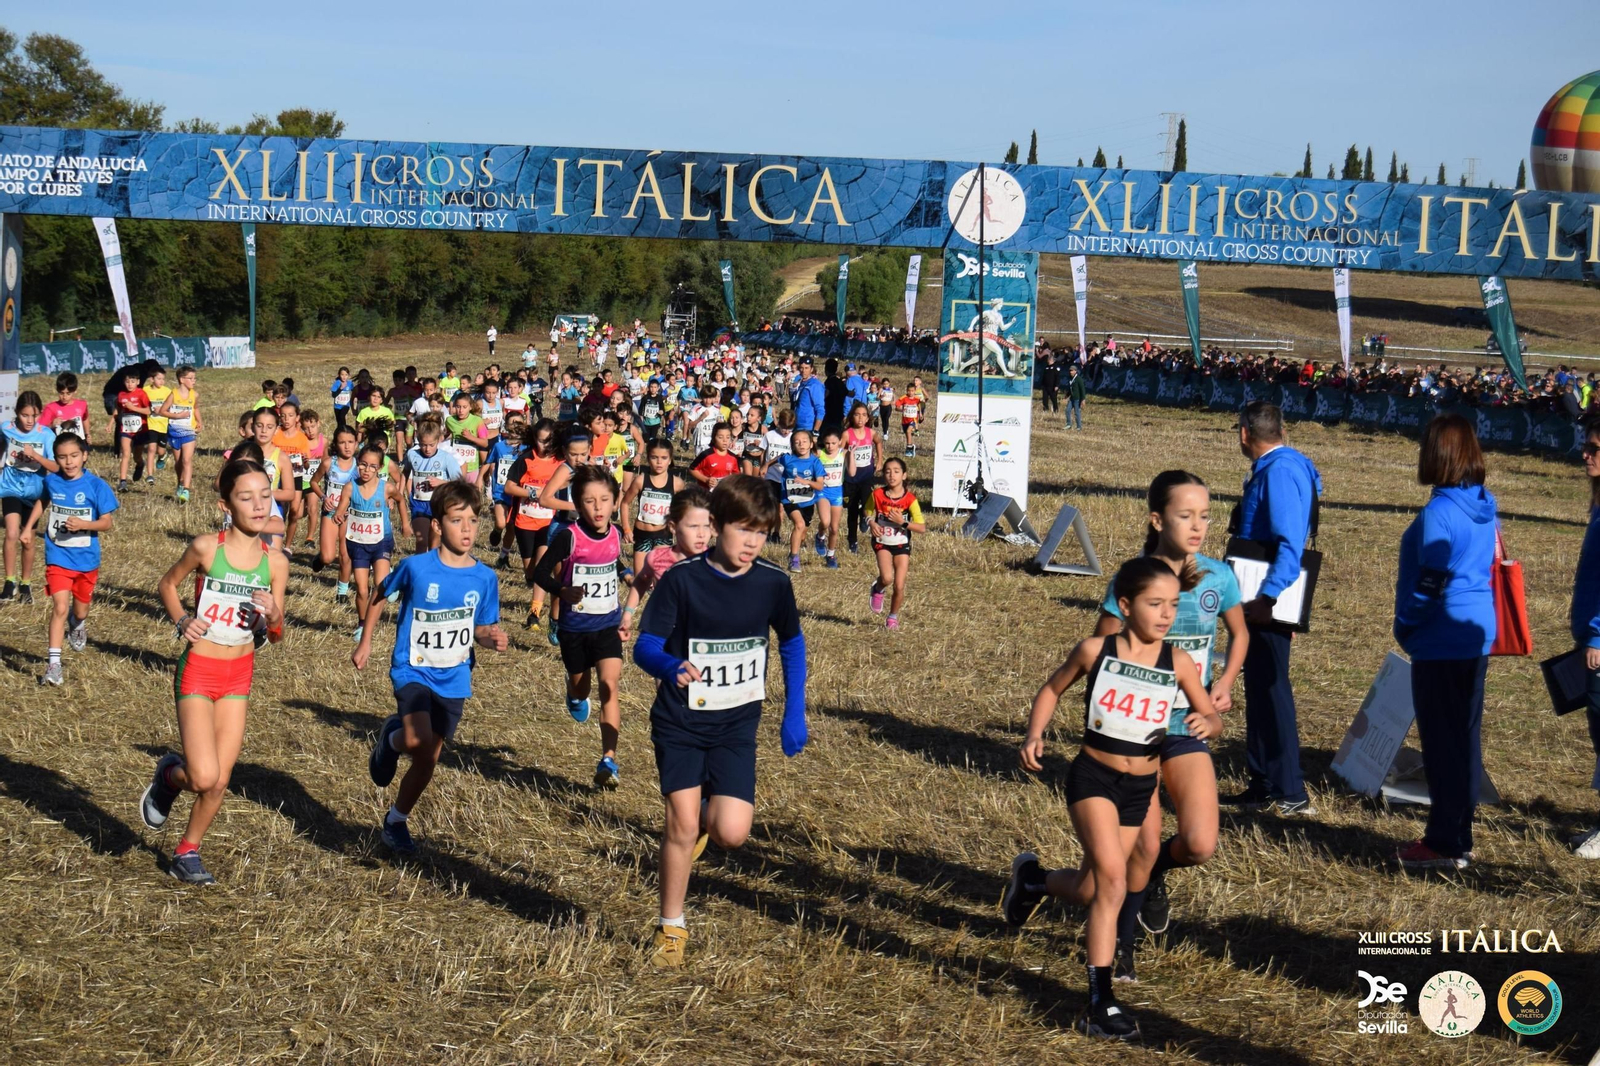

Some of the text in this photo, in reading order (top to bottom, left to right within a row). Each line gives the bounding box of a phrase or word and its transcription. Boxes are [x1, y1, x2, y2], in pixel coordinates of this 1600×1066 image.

[0, 154, 148, 172] ATO DE ANDALUCÍA
[371, 155, 494, 188] CROSS
[42, 169, 54, 182] A
[57, 170, 114, 184] TRAVÉS
[208, 148, 367, 204] XLIII
[28, 183, 82, 196] CLUBES
[551, 150, 852, 227] ITÁLICA
[955, 172, 1019, 202] ITLICA
[371, 189, 539, 210] INTERNACIONAL
[1069, 179, 1228, 238] XLIII
[1234, 188, 1358, 224] CROSS
[208, 204, 509, 229] INTERNATIONAL CROSS COUNTRY
[1233, 223, 1403, 247] INTERNACIONAL
[1068, 236, 1372, 265] INTERNATIONAL CROSS COUNTRY
[992, 269, 1025, 278] Sevilla
[124, 419, 140, 427] 4140
[855, 453, 871, 461] 245
[825, 471, 842, 481] 367
[350, 522, 381, 535] 4443
[224, 584, 255, 597] ITÁLIC
[581, 579, 616, 598] 4213
[417, 628, 470, 649] 4170
[712, 642, 749, 653] ITÁLICA
[700, 659, 758, 687] 4111
[1124, 667, 1163, 683] ITÁLICA
[1098, 688, 1168, 724] 4413
